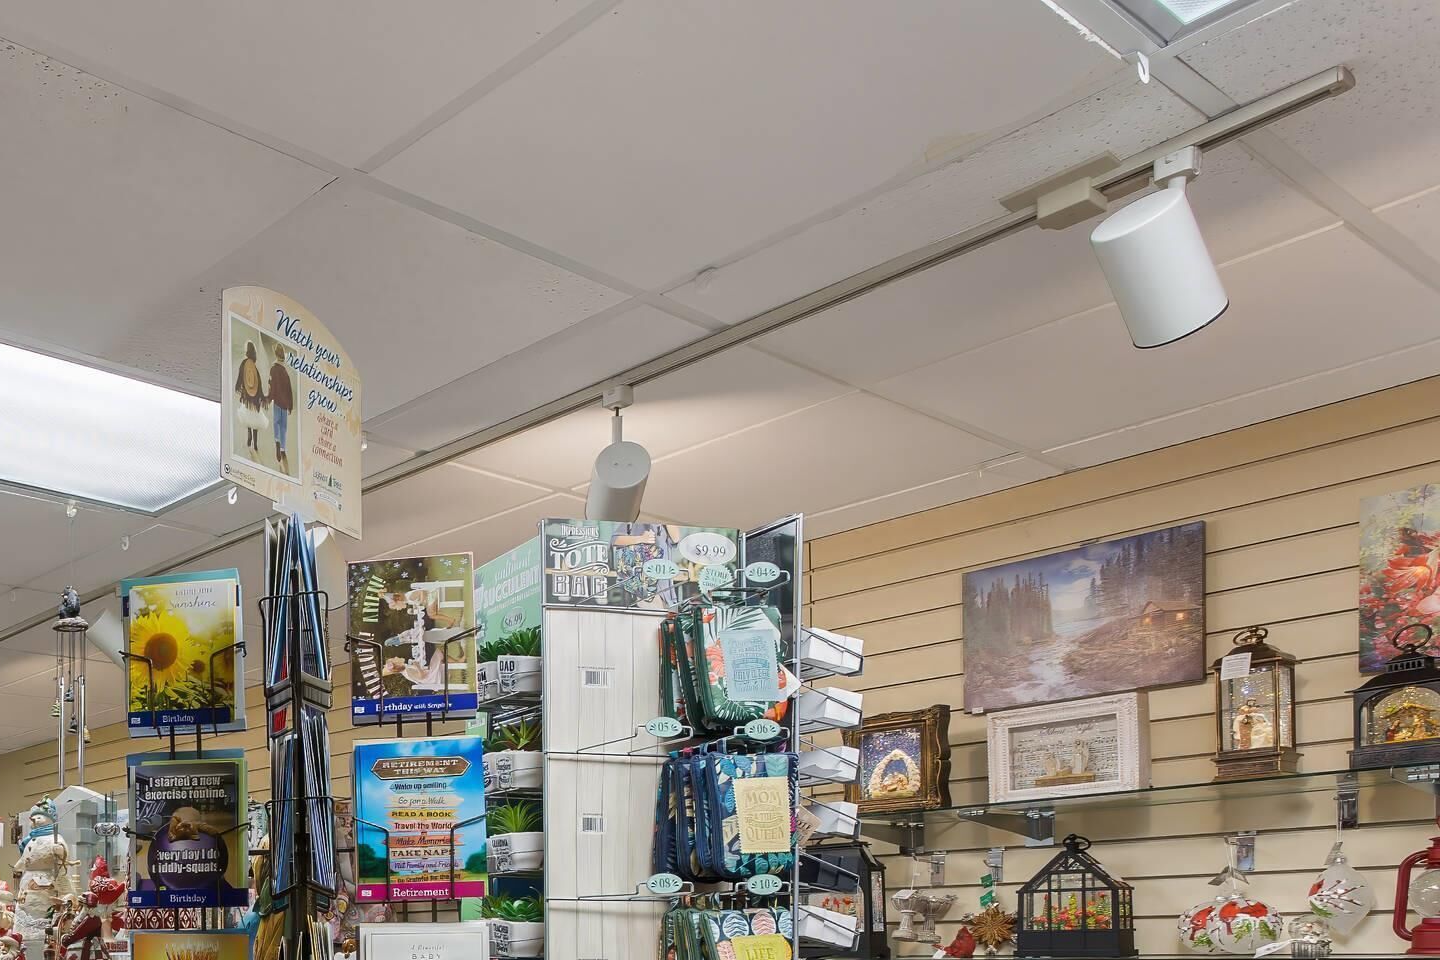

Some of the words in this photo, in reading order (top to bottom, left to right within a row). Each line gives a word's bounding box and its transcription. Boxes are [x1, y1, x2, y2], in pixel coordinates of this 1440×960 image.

[275, 308, 314, 351] Watch
[314, 345, 341, 369] your
[287, 351, 353, 402] relationships
[695, 544, 726, 557] $9.99
[551, 543, 609, 570] TOTE
[655, 565, 667, 575] 01
[756, 568, 769, 577] 04
[552, 574, 609, 599] BAG
[363, 575, 387, 623] AMEN!
[500, 660, 515, 672] DAD
[162, 715, 195, 723] Birthday
[658, 722, 669, 732] 05
[756, 723, 769, 734] 06
[382, 759, 459, 769] RETIREMENT
[155, 776, 190, 787] started
[200, 777, 221, 786] new
[145, 790, 187, 801] exercise
[189, 788, 227, 799] routine.
[745, 790, 783, 809] MOM
[395, 822, 416, 830] Travel
[431, 822, 452, 830] World
[745, 825, 784, 843] QUEEN
[417, 836, 452, 845] Memorie
[182, 849, 200, 861] day
[659, 877, 671, 888] 08
[758, 879, 771, 890] 10
[393, 888, 449, 897] Retirement
[170, 895, 207, 903] Birthday
[746, 948, 775, 960] LIFE
